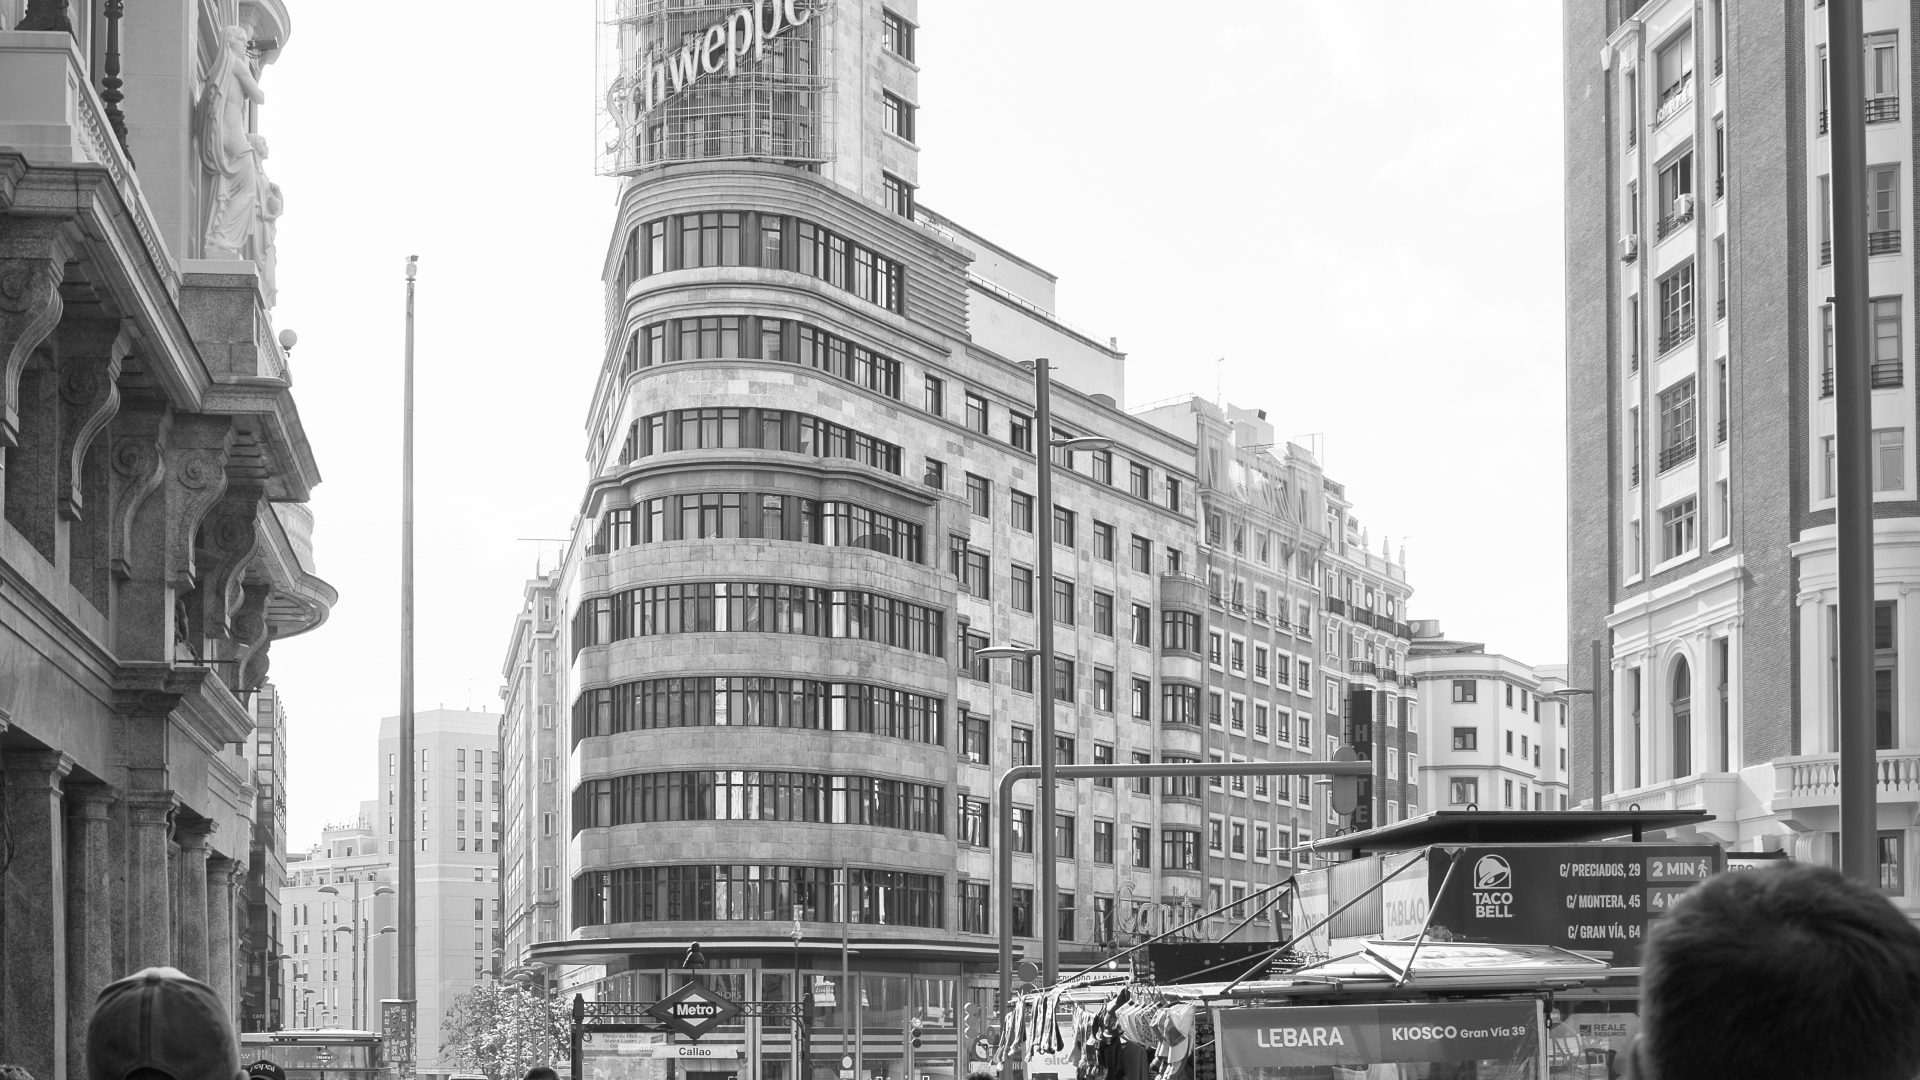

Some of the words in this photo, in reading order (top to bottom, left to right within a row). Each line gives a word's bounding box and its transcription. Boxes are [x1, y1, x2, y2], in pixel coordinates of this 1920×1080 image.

[606, 0, 835, 154] Schweppe
[1559, 863, 1570, 878] C/
[1572, 863, 1626, 878] PRECIADOS,
[1629, 863, 1641, 877] 29
[1652, 861, 1663, 877] 2
[1667, 862, 1695, 876] MIN
[1472, 892, 1513, 905] TACO
[1566, 894, 1577, 909] C/
[1579, 894, 1626, 909] MONTERA,
[1629, 895, 1641, 908] 45
[1652, 892, 1664, 907] 4
[1386, 898, 1425, 927] TABLAO
[1475, 905, 1513, 918] BELL
[1568, 925, 1579, 940] C/
[1580, 925, 1606, 939] GRAN
[1608, 922, 1626, 940] VÍA,
[1629, 925, 1641, 939] 64
[676, 1004, 714, 1016] Metro
[1256, 1026, 1345, 1048] LEBARA
[1392, 1026, 1457, 1041] KIOSCO
[1460, 1028, 1489, 1039] Gran
[1490, 1027, 1510, 1038] Vía
[1511, 1027, 1526, 1036] 39
[678, 1047, 711, 1056] Callao
